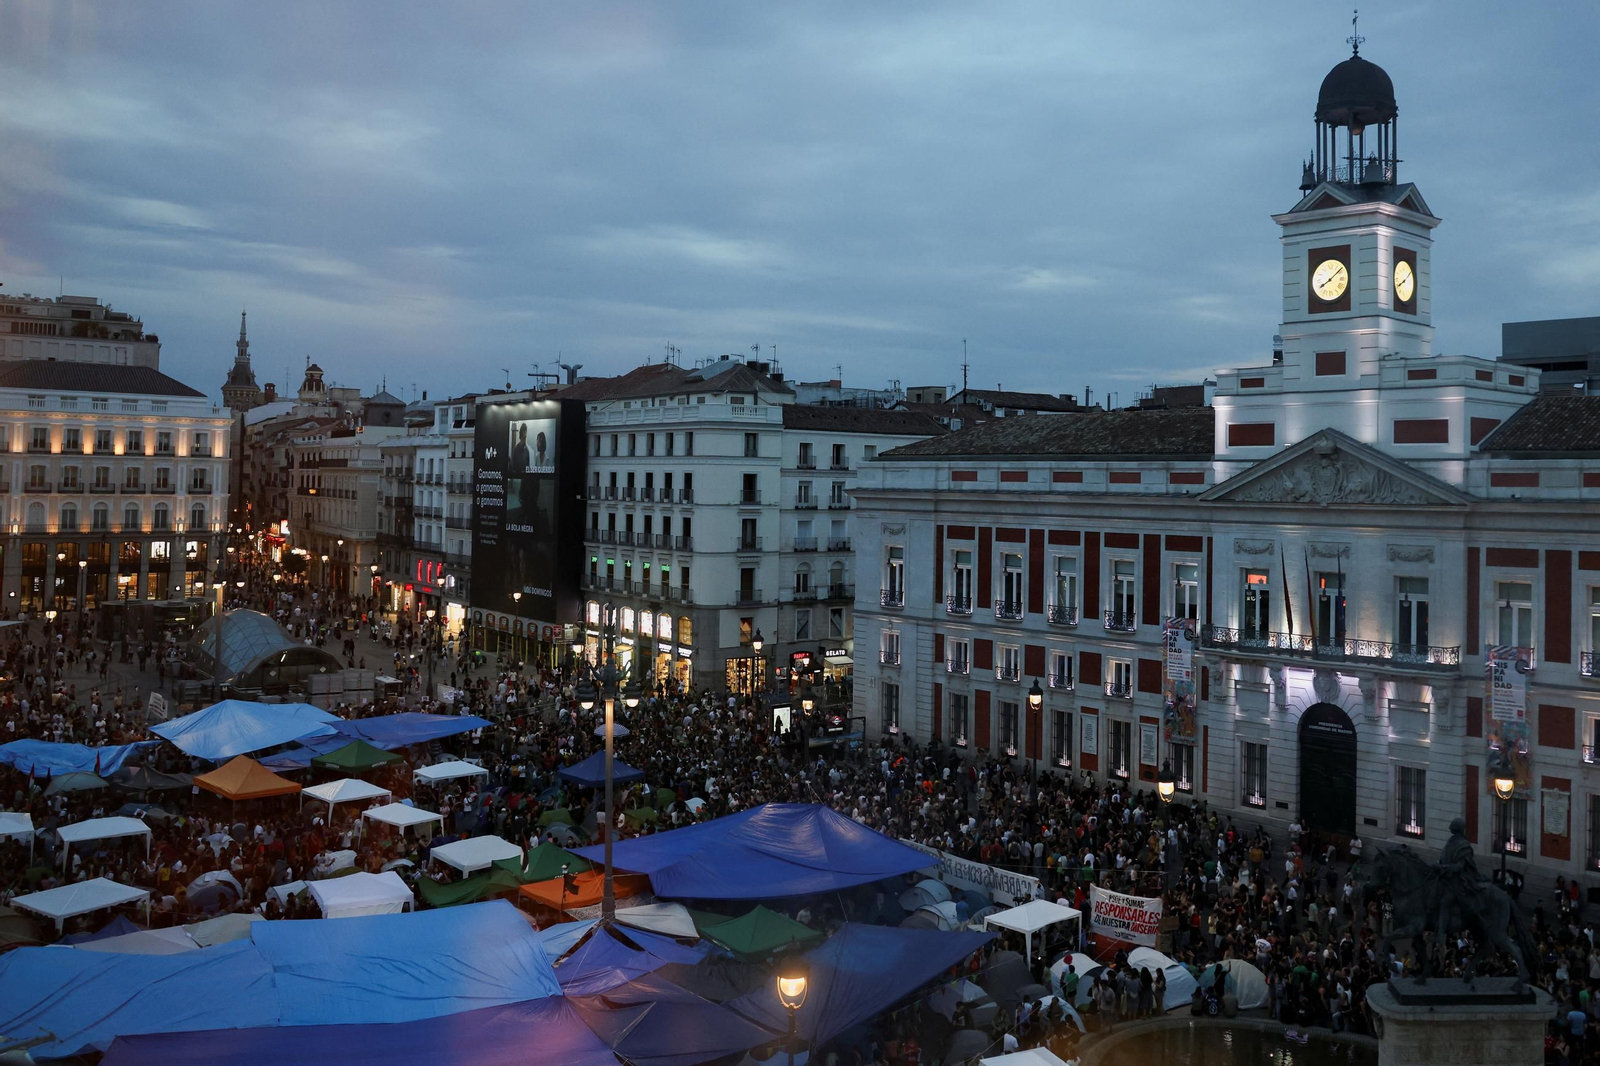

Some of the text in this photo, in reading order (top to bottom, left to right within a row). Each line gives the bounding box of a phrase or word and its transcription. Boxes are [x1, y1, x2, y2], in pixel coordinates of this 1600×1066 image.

[478, 468, 503, 481] Ganamos,
[480, 484, 504, 495] ganamos,
[480, 497, 503, 508] ganamos
[506, 523, 511, 531] LA
[511, 523, 520, 531] BOLA
[521, 524, 534, 533] NEGRA
[531, 587, 552, 598] DOMINGOS
[1094, 901, 1160, 925] RESPONSABLES
[1094, 914, 1101, 925] DE
[1101, 915, 1131, 931] NUESTRA
